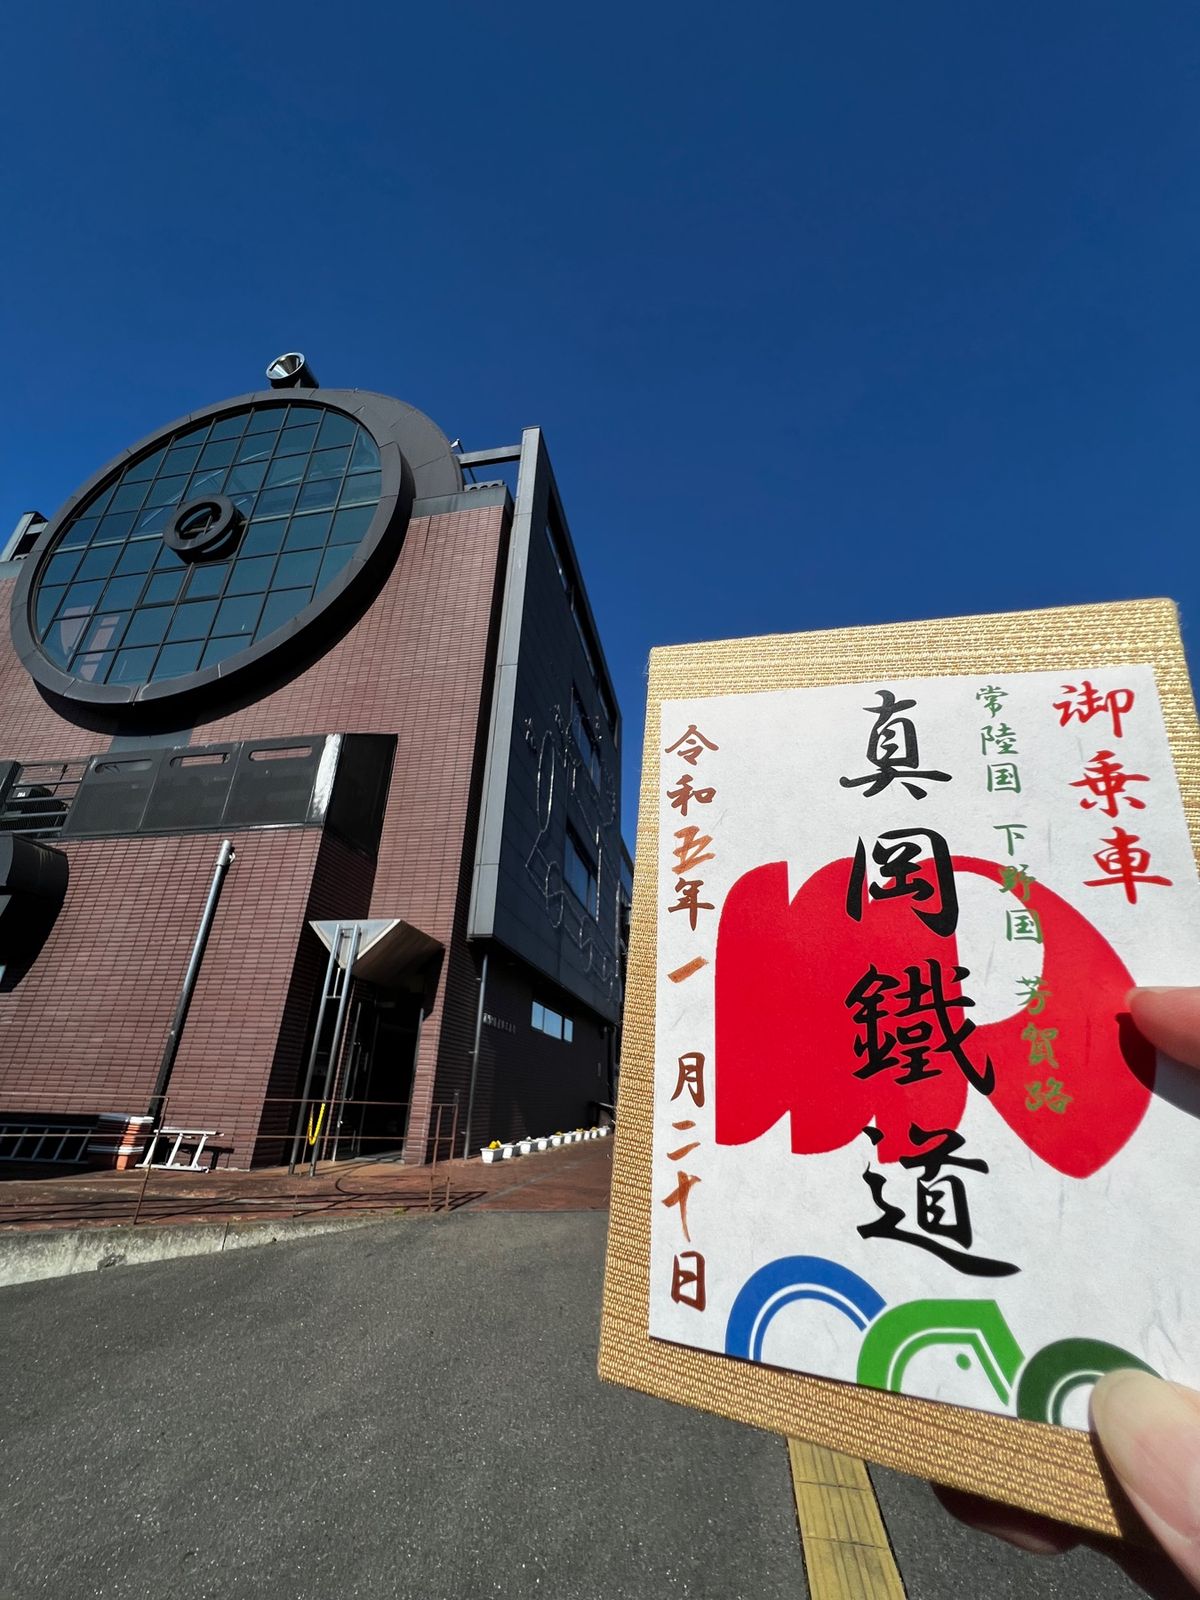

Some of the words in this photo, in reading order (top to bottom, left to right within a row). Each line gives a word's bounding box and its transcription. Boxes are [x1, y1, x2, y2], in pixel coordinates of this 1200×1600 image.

[976, 685, 1021, 794] 常陸国
[1052, 680, 1173, 905] 御乗車
[992, 823, 1043, 944] 下野国
[839, 689, 1022, 1277] 真岡鐵道
[1014, 976, 1073, 1114] 芳賀路
